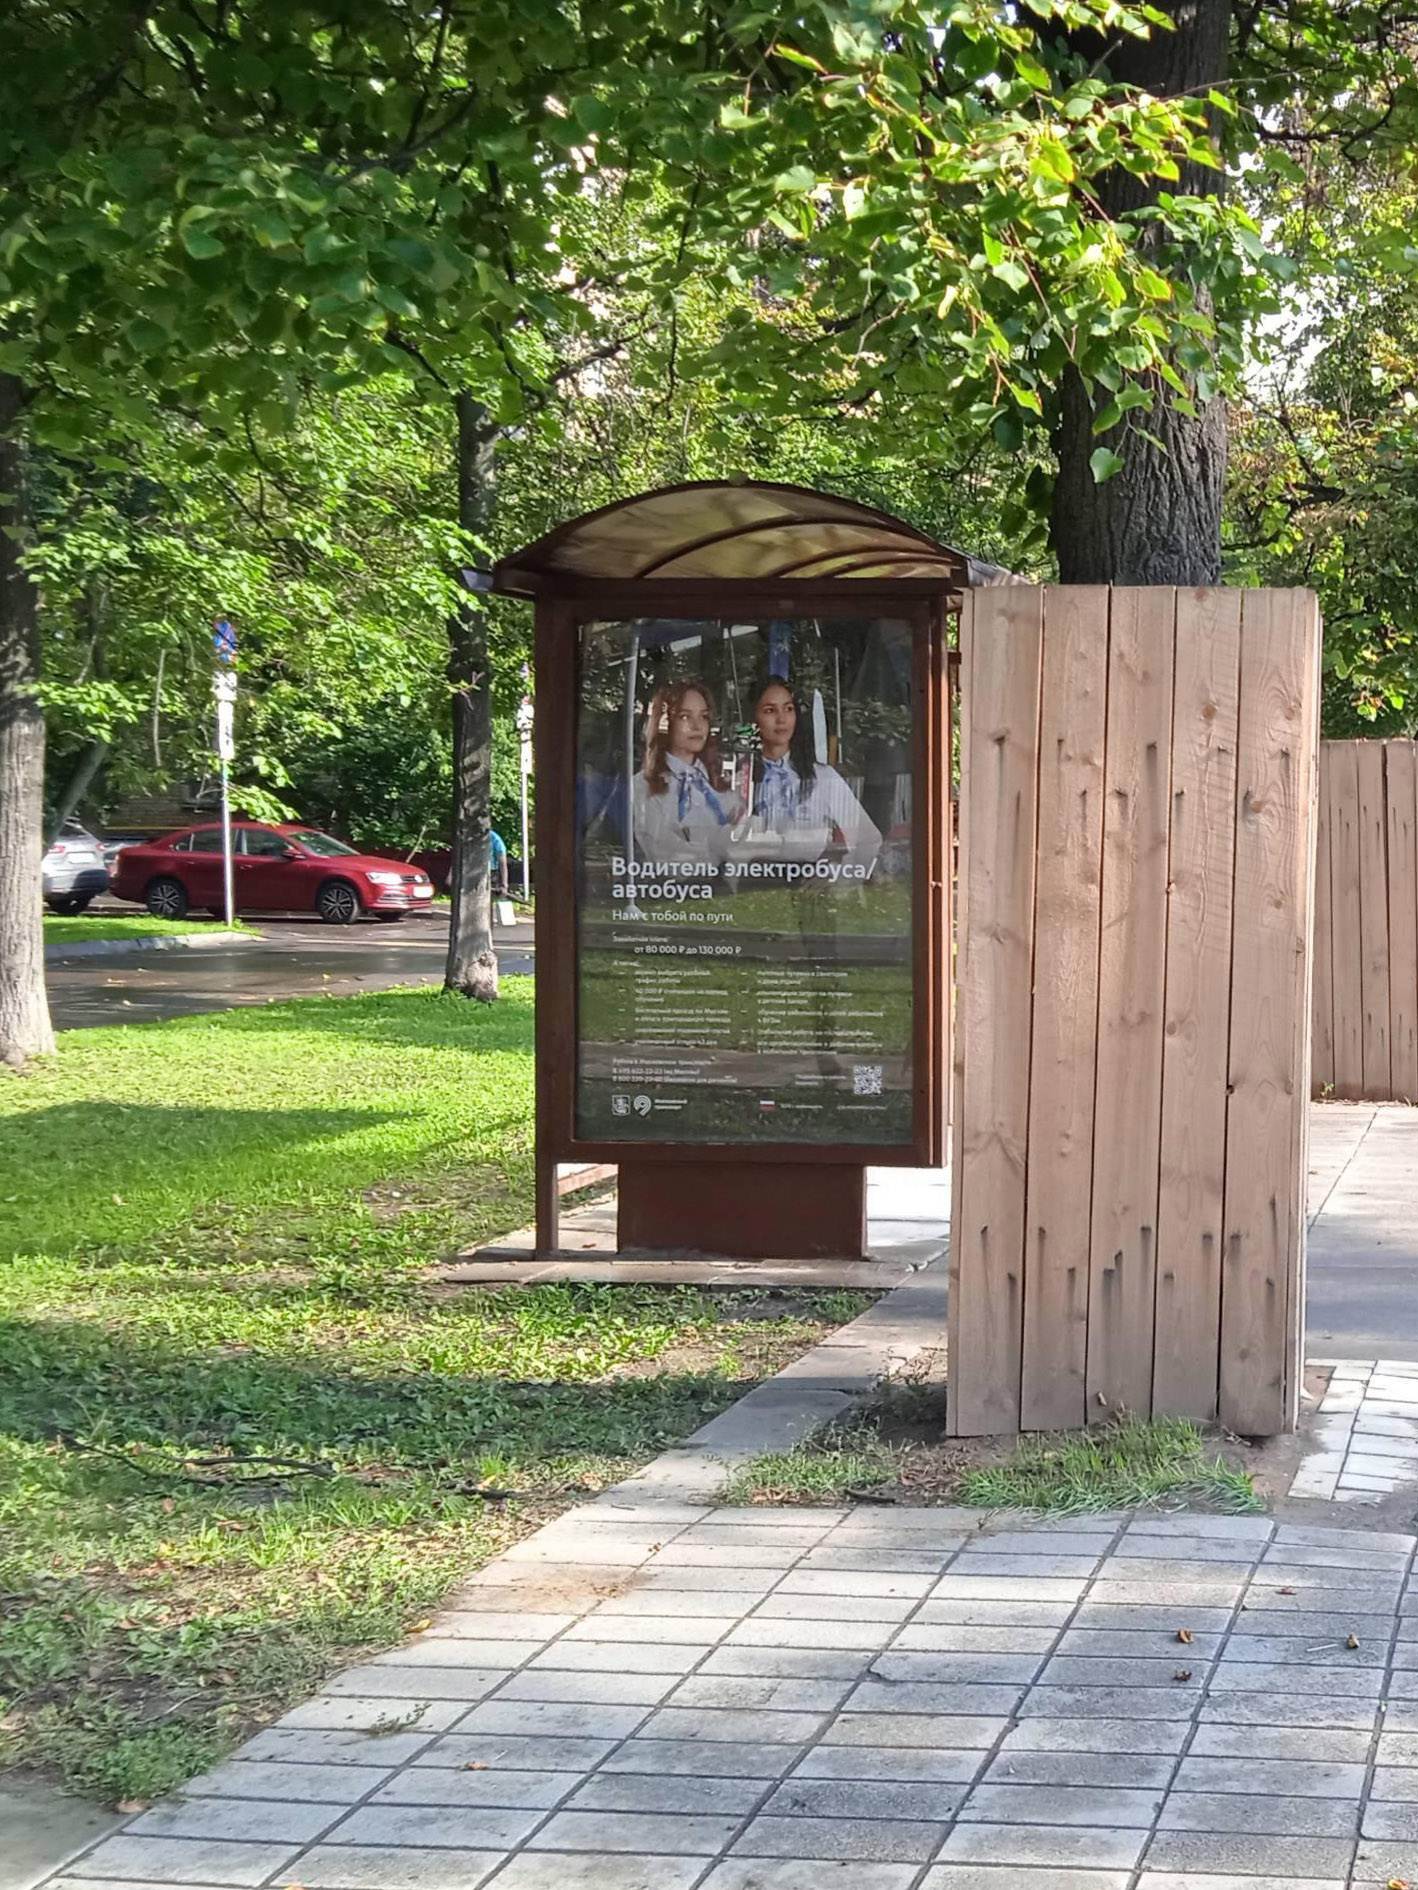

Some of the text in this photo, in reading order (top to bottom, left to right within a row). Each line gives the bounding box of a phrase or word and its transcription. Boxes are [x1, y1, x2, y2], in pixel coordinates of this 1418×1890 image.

[612, 856, 877, 882] Водитель электробуса/
[612, 879, 713, 903] автобуса
[612, 909, 733, 924] Нам с тобой по пути
[634, 946, 644, 954] от
[645, 945, 658, 954] 80
[660, 945, 677, 954] 000
[686, 946, 697, 955] до
[699, 945, 714, 955] 130
[715, 946, 734, 955] 000
